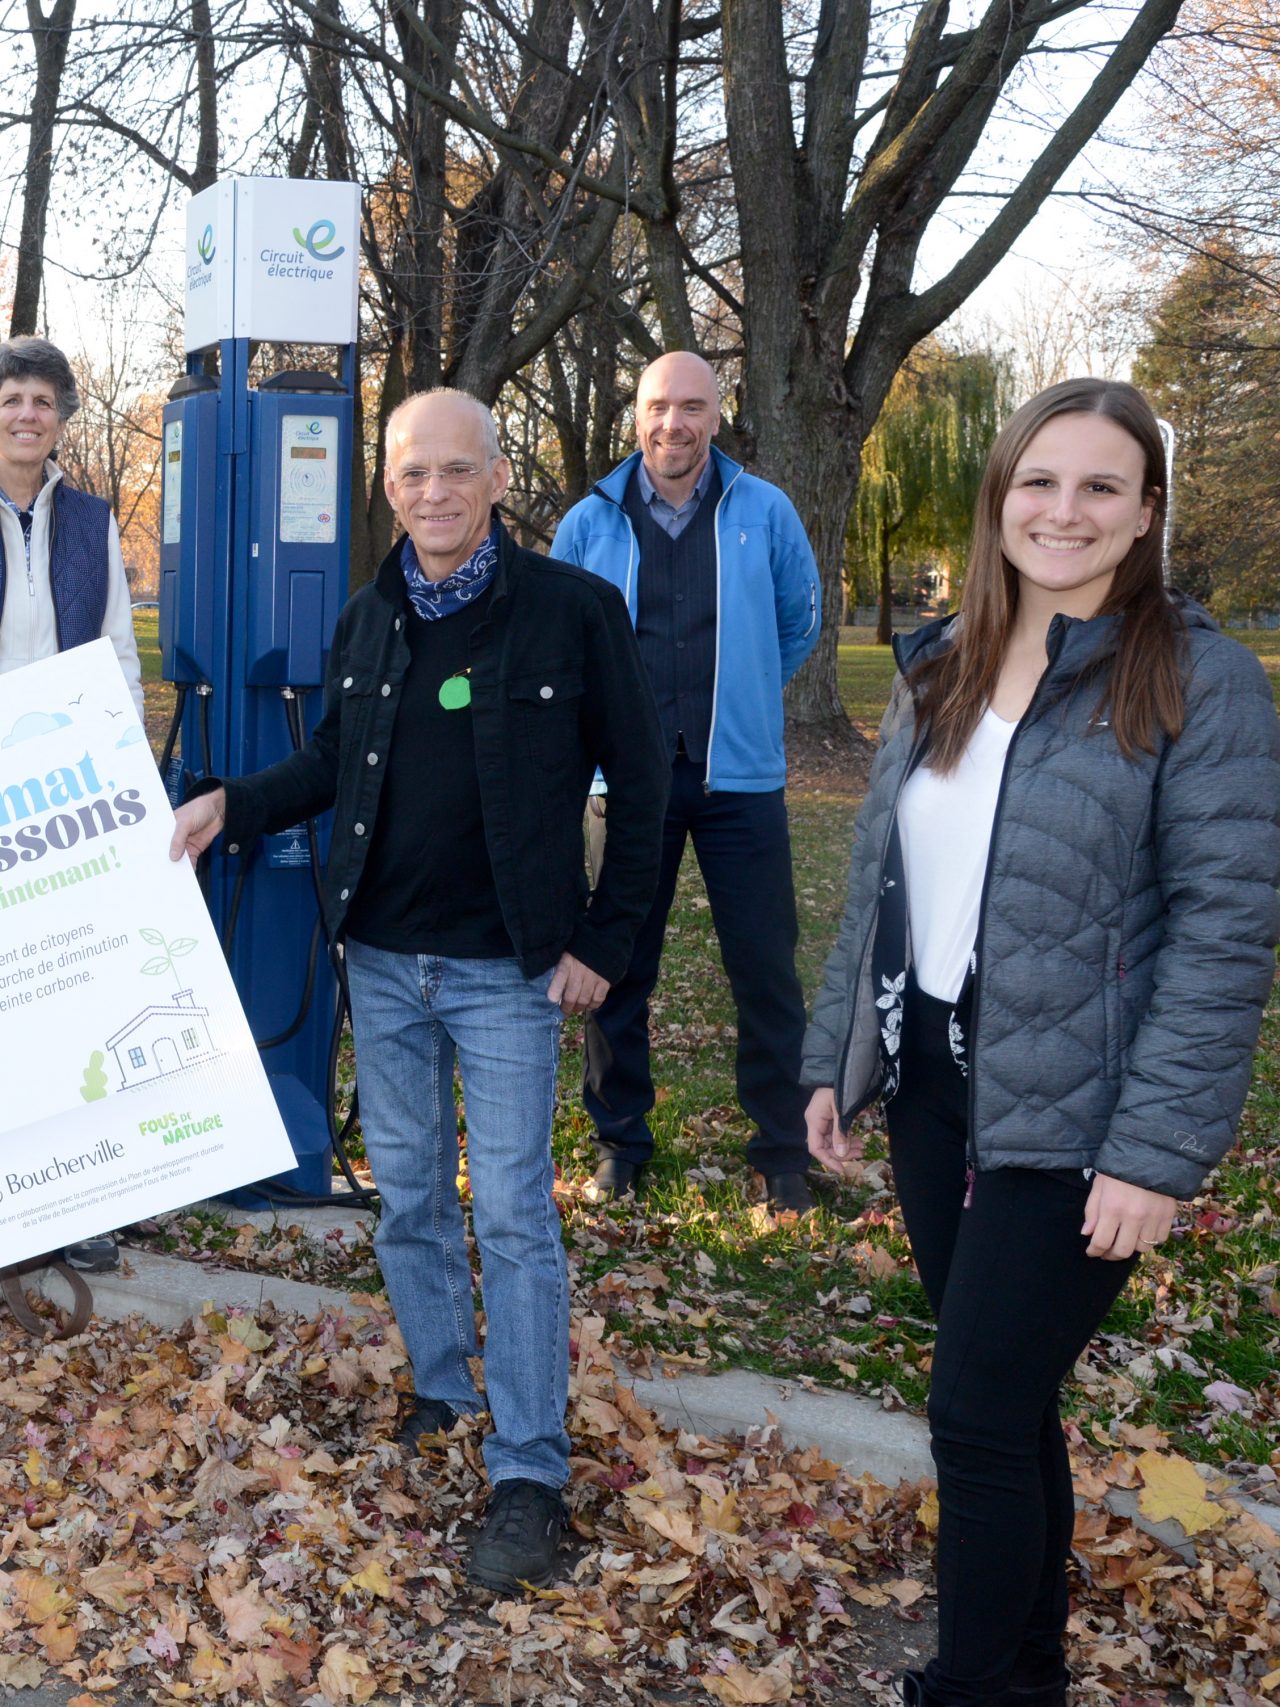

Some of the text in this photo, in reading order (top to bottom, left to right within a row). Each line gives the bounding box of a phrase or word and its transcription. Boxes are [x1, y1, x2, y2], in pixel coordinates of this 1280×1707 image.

[260, 249, 304, 264] Circuit
[268, 263, 334, 281] électrique
[21, 942, 38, 958] de
[40, 922, 95, 951] citoyens
[37, 959, 54, 975] de
[57, 933, 129, 969] diminution
[36, 969, 95, 999] carbone.
[138, 1111, 192, 1137] FOUS DE
[162, 1114, 223, 1146] NATURE
[5, 1139, 125, 1195] Boucherville
